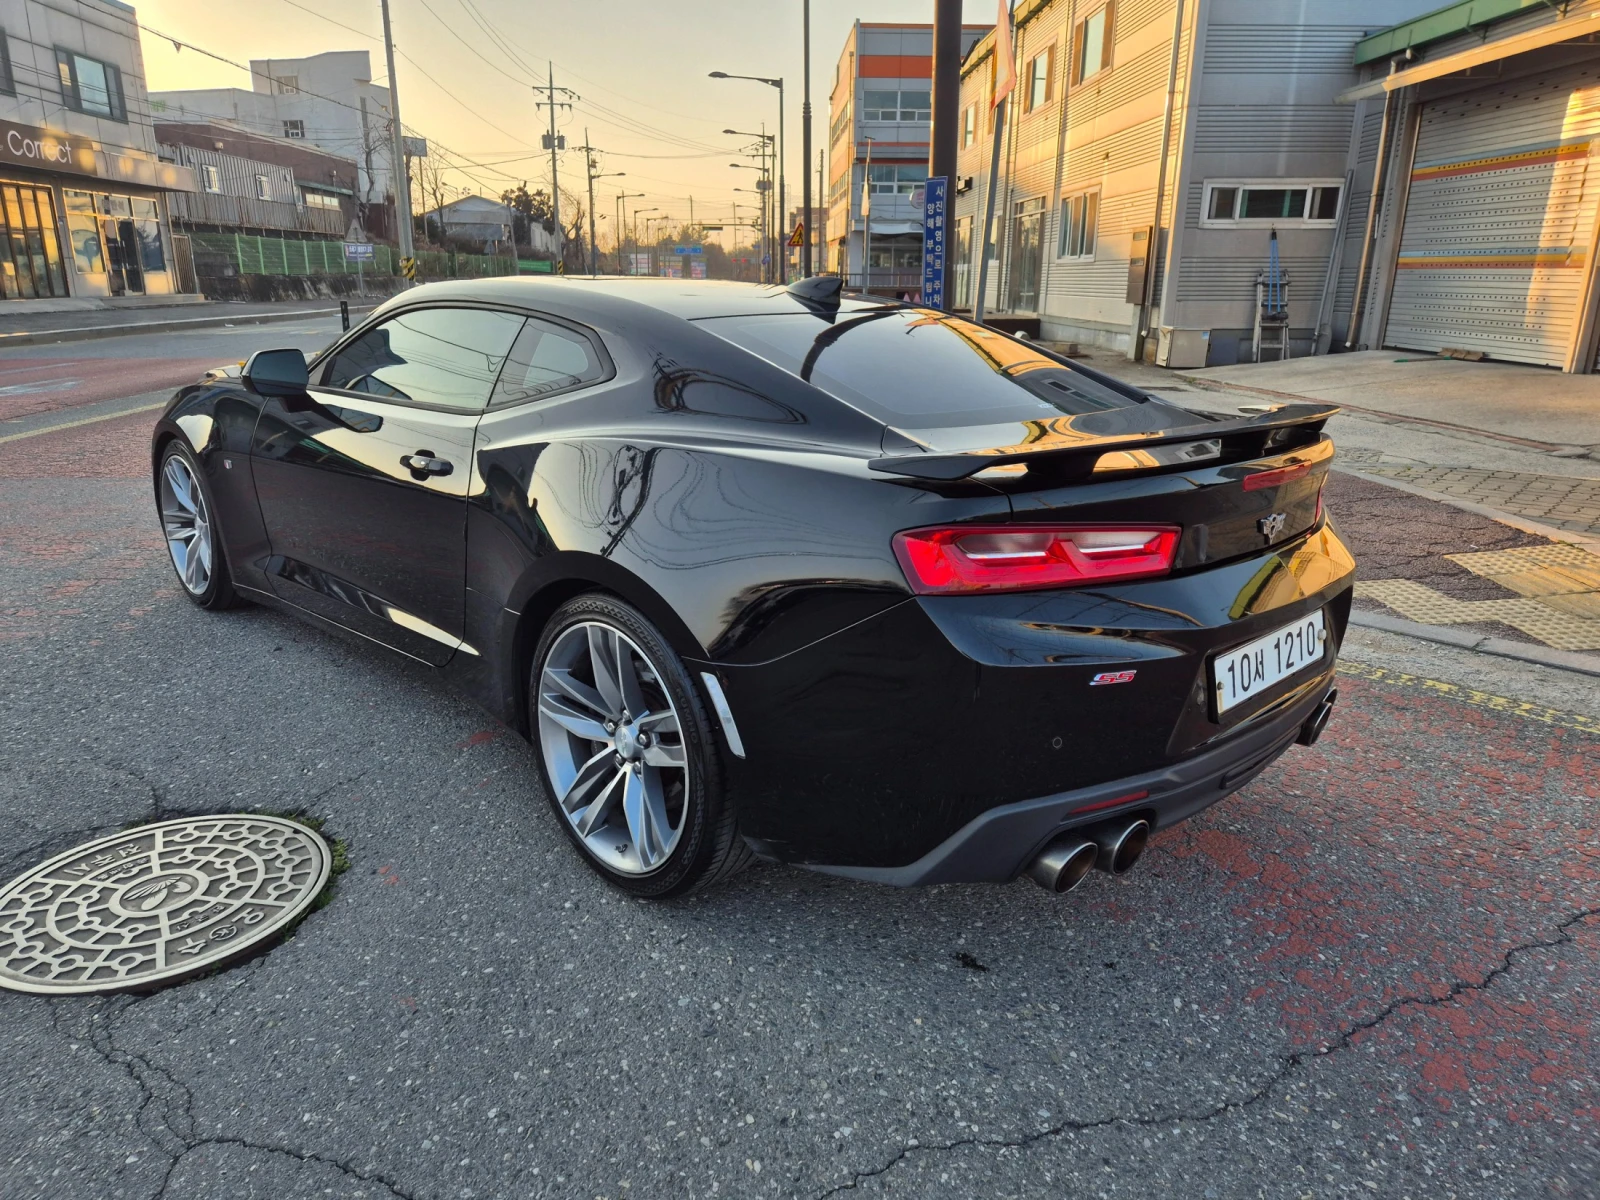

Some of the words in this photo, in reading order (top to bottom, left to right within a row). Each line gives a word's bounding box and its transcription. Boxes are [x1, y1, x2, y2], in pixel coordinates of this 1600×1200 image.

[7, 130, 72, 164] Correct
[927, 203, 935, 229] 양해
[933, 280, 941, 304] 주차
[1228, 649, 1265, 698] 10서
[1274, 621, 1316, 674] 1210
[1089, 670, 1137, 686] SS
[63, 843, 142, 876] 전주시
